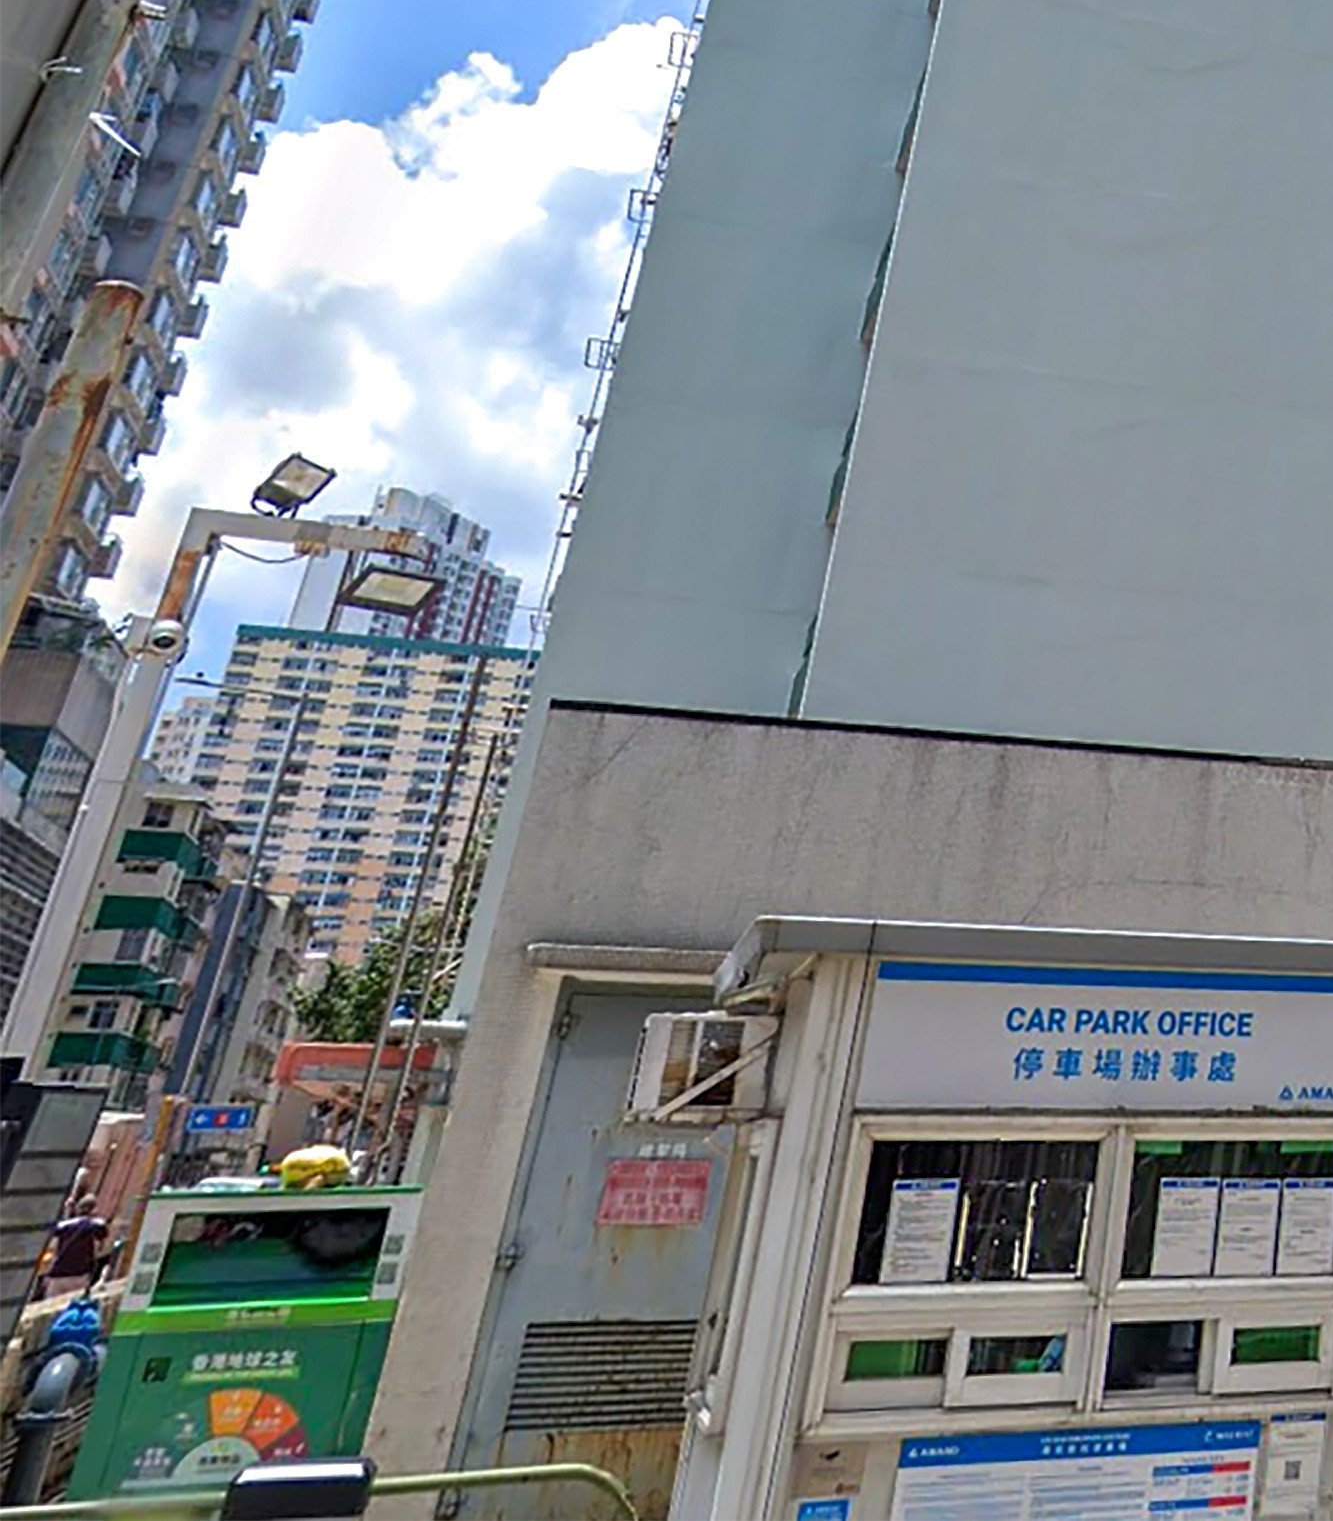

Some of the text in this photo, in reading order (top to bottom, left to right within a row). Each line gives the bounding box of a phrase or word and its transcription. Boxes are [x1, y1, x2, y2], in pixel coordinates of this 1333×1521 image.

[1006, 1007, 1253, 1037] CAR PARK OFFICE
[1013, 1047, 1237, 1082] 停車場辦事處
